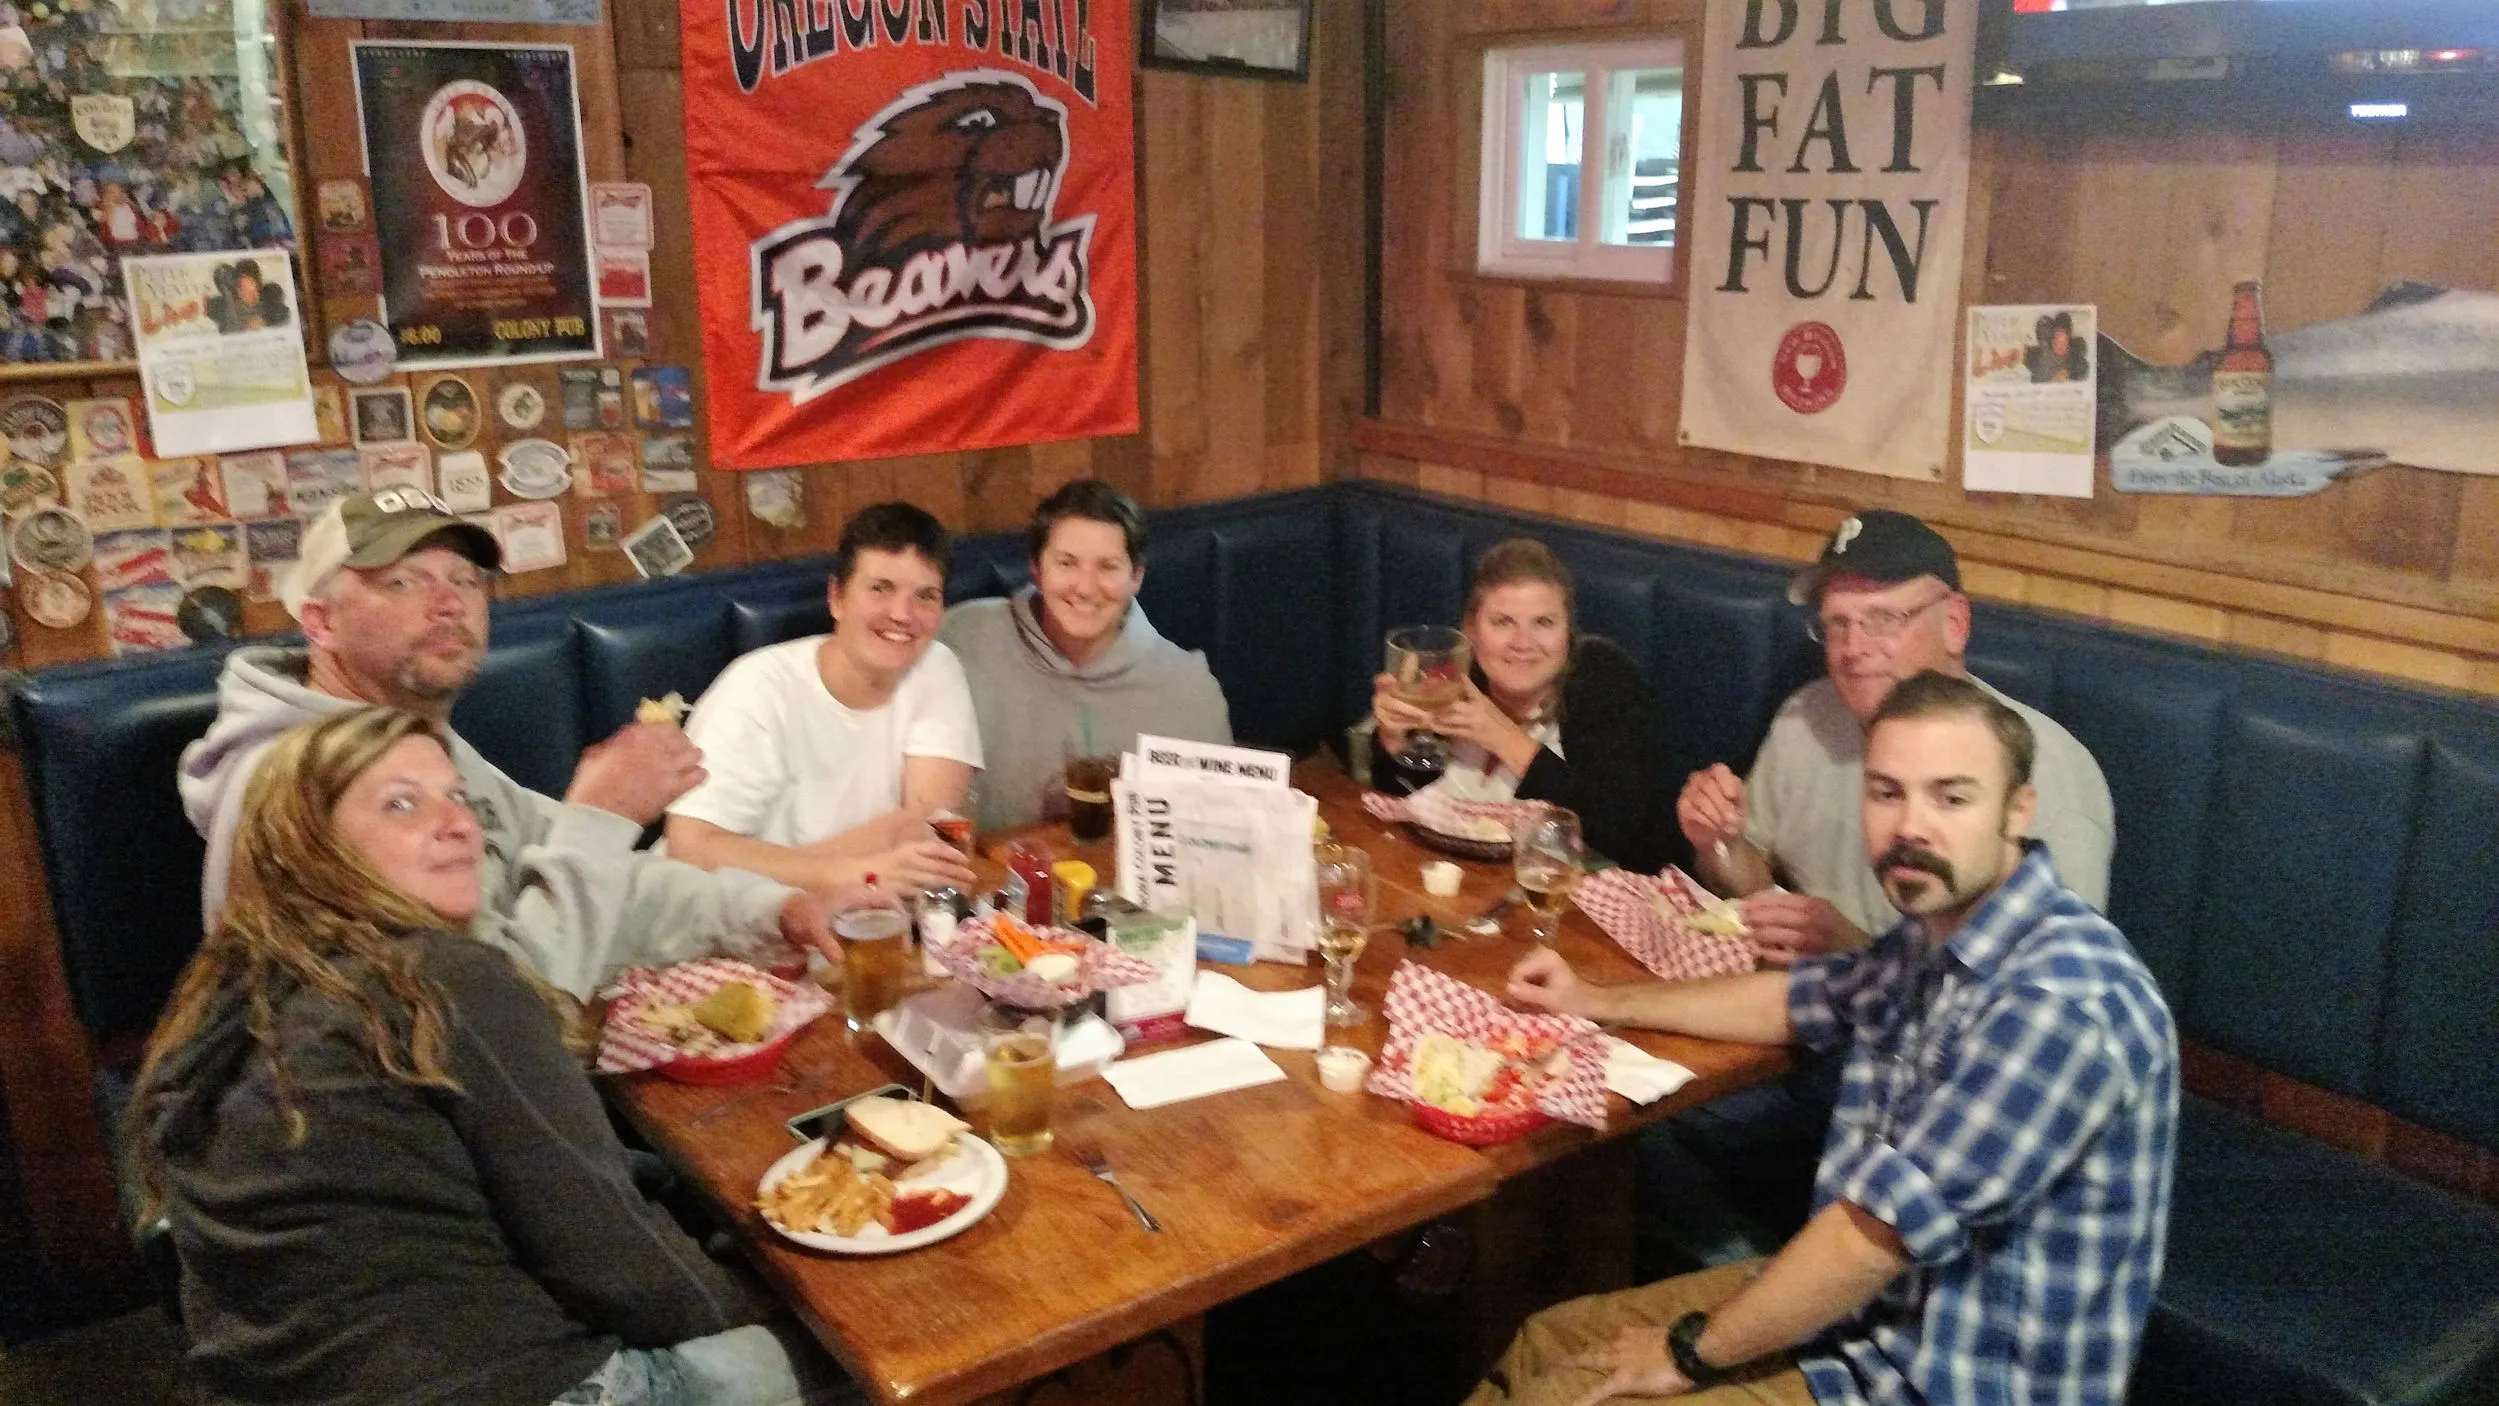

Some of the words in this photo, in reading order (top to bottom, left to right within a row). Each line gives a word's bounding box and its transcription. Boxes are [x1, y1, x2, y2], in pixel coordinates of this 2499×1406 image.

[729, 0, 948, 93] OREGON
[1731, 62, 1946, 174] FAT
[417, 262, 493, 279] PENDLETON
[431, 212, 538, 250] 100
[1715, 195, 1940, 304] FUN
[493, 319, 551, 340] COLONY
[771, 236, 1080, 371] Beavers
[1198, 756, 1234, 775] WINE
[1239, 762, 1279, 782] MENU
[1144, 797, 1179, 887] MENU
